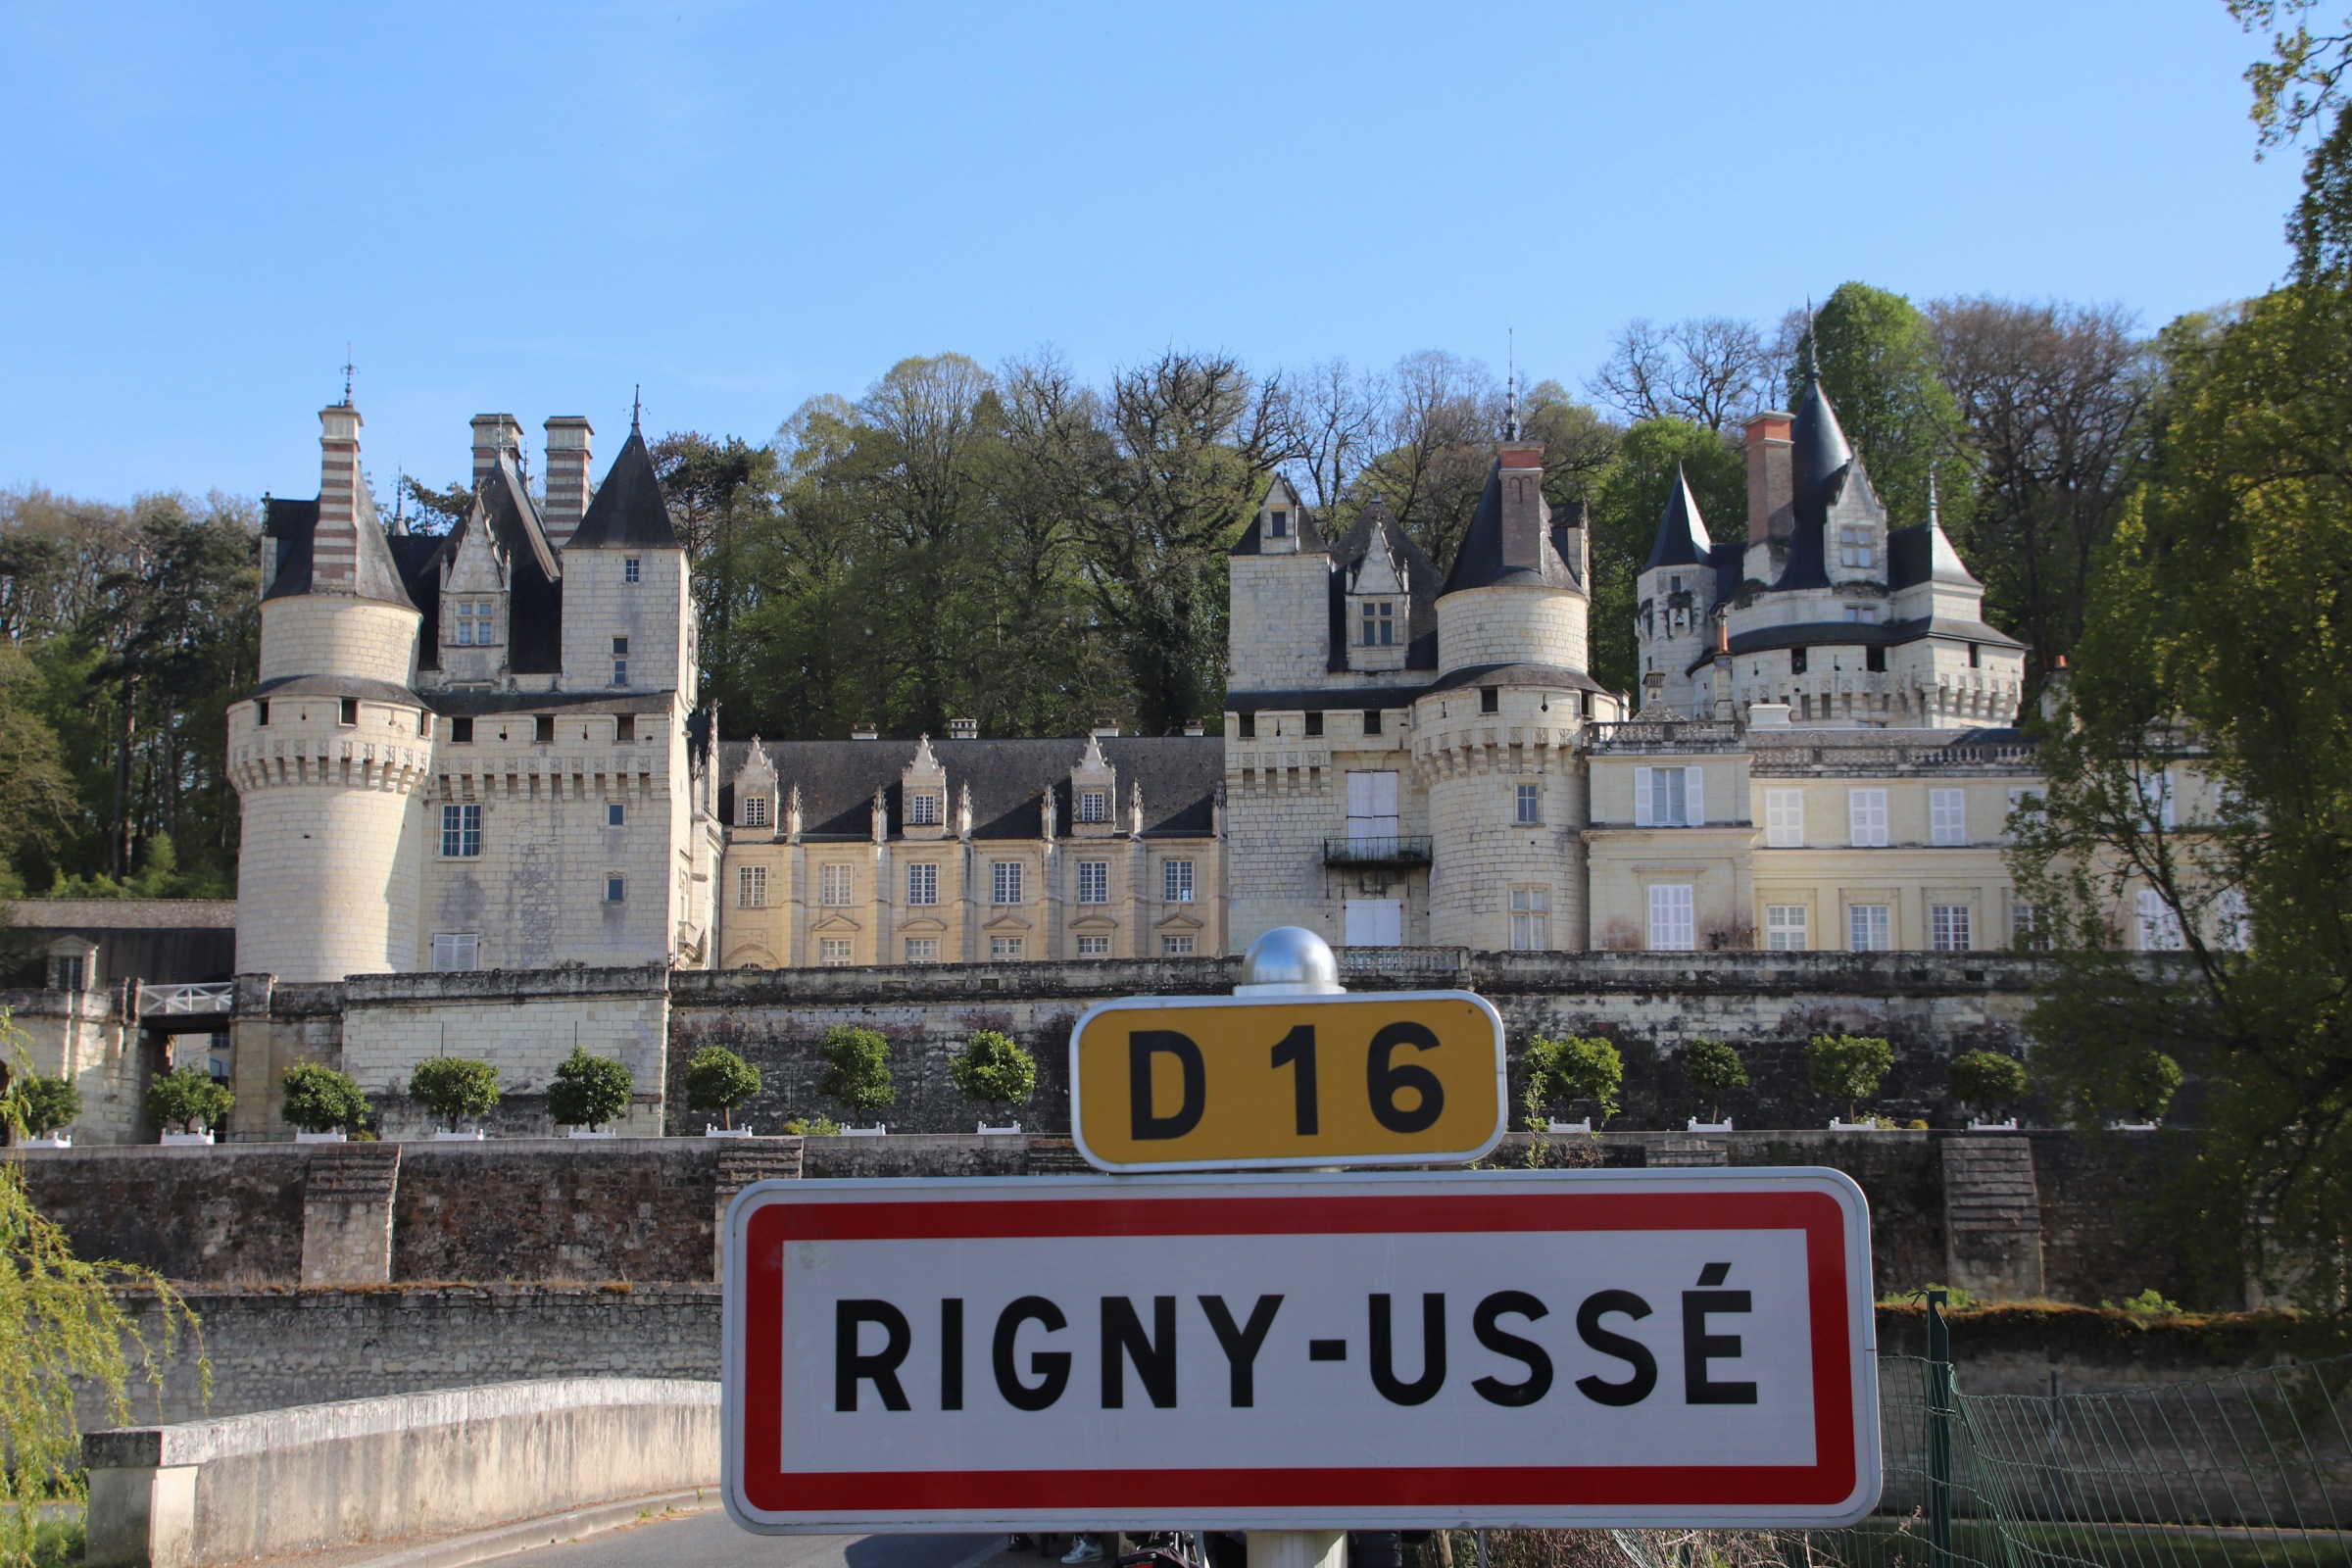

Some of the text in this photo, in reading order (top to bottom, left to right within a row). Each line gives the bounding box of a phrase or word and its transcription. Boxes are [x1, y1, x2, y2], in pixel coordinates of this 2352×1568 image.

[1128, 1020, 1446, 1142] D 16
[835, 1262, 1758, 1412] RIGNY-USSÉ
